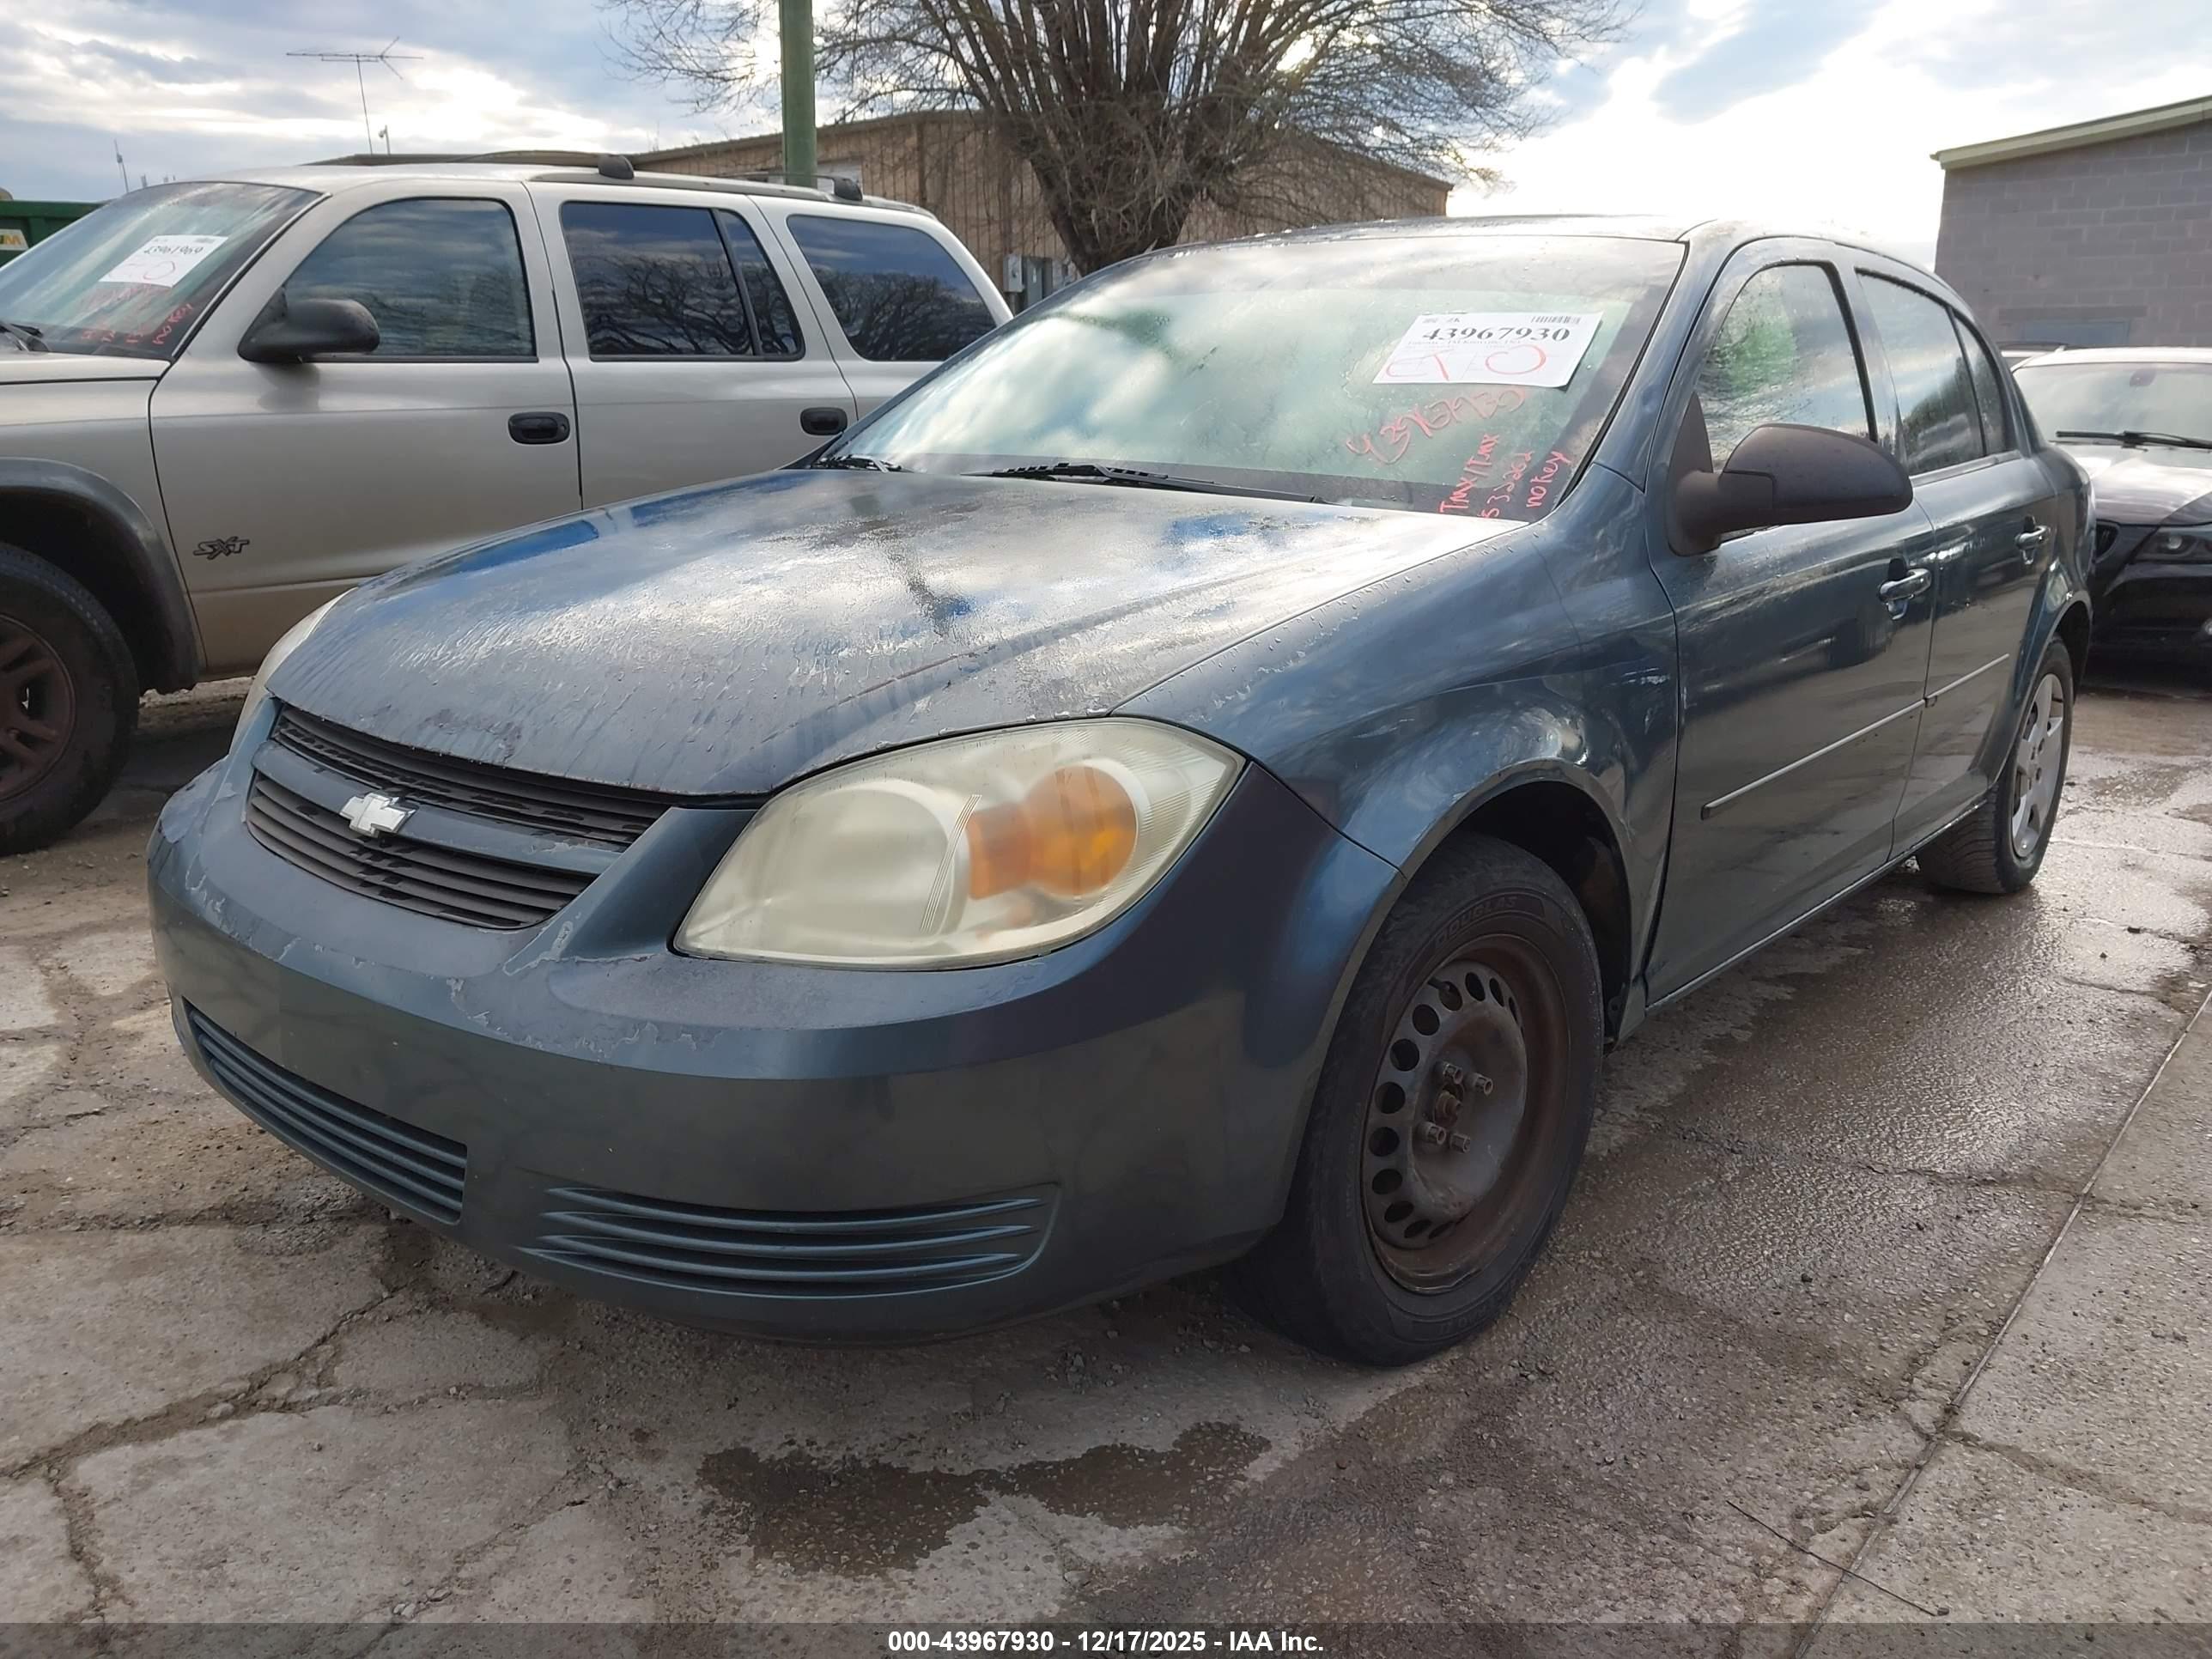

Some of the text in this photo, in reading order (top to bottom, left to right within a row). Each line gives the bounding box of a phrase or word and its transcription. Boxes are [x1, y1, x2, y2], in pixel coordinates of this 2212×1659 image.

[1421, 326, 1571, 343] 43967930
[192, 536, 250, 560] SXT
[1437, 896, 1518, 944] DOUGLAS
